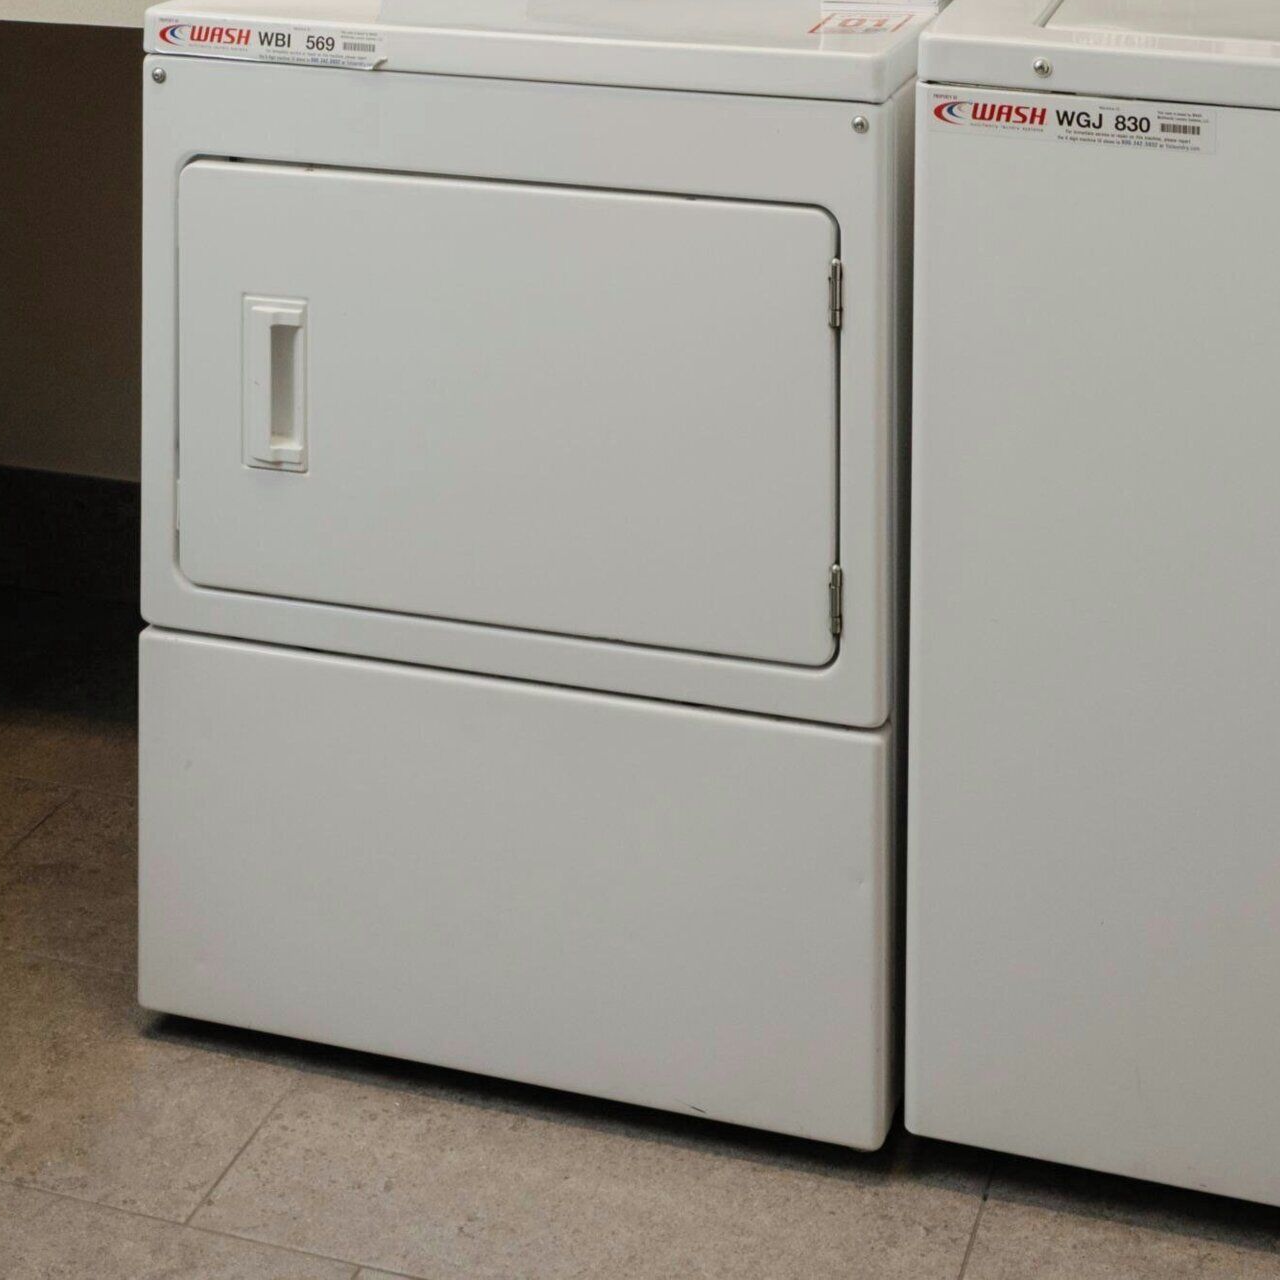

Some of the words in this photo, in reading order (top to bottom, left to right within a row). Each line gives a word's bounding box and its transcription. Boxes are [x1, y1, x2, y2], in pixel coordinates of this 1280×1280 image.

[189, 25, 251, 46] WASH
[258, 31, 291, 48] WBI
[306, 35, 336, 52] 569
[971, 102, 1047, 126] WASH
[1055, 109, 1103, 130] WGJ
[1114, 115, 1151, 133] 830
